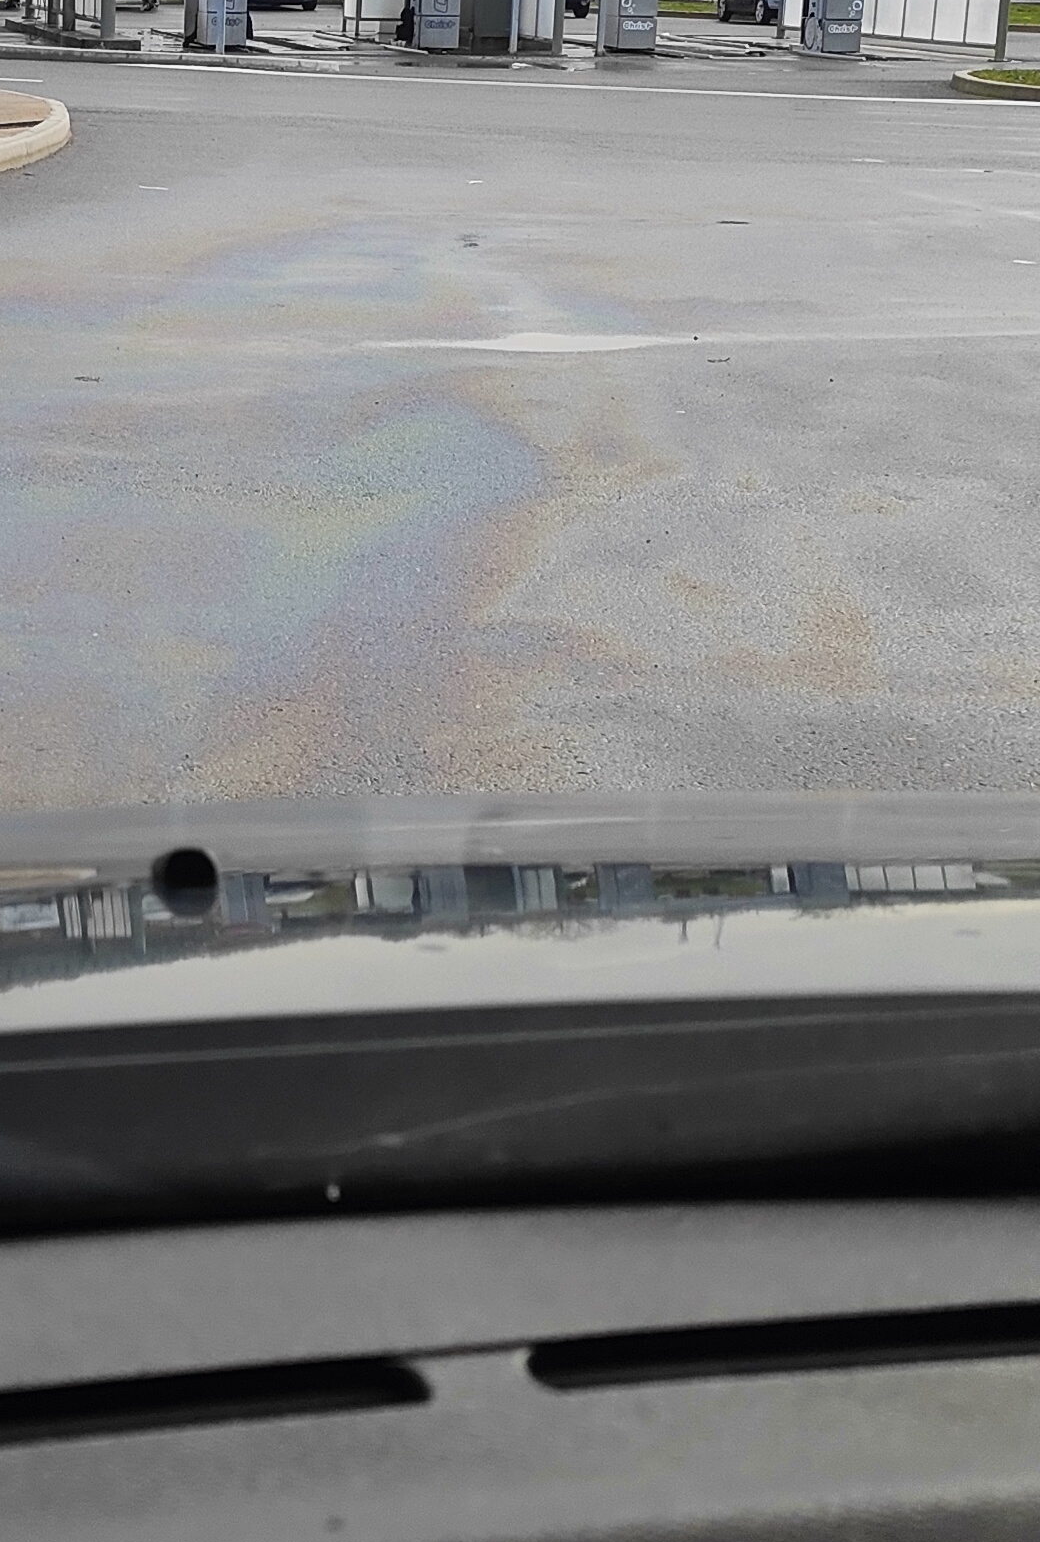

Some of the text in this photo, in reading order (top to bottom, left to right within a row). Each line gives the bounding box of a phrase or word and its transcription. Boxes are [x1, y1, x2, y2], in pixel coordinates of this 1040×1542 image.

[425, 19, 456, 29] Christ
[622, 20, 654, 30] Christ
[828, 23, 859, 33] Christ
